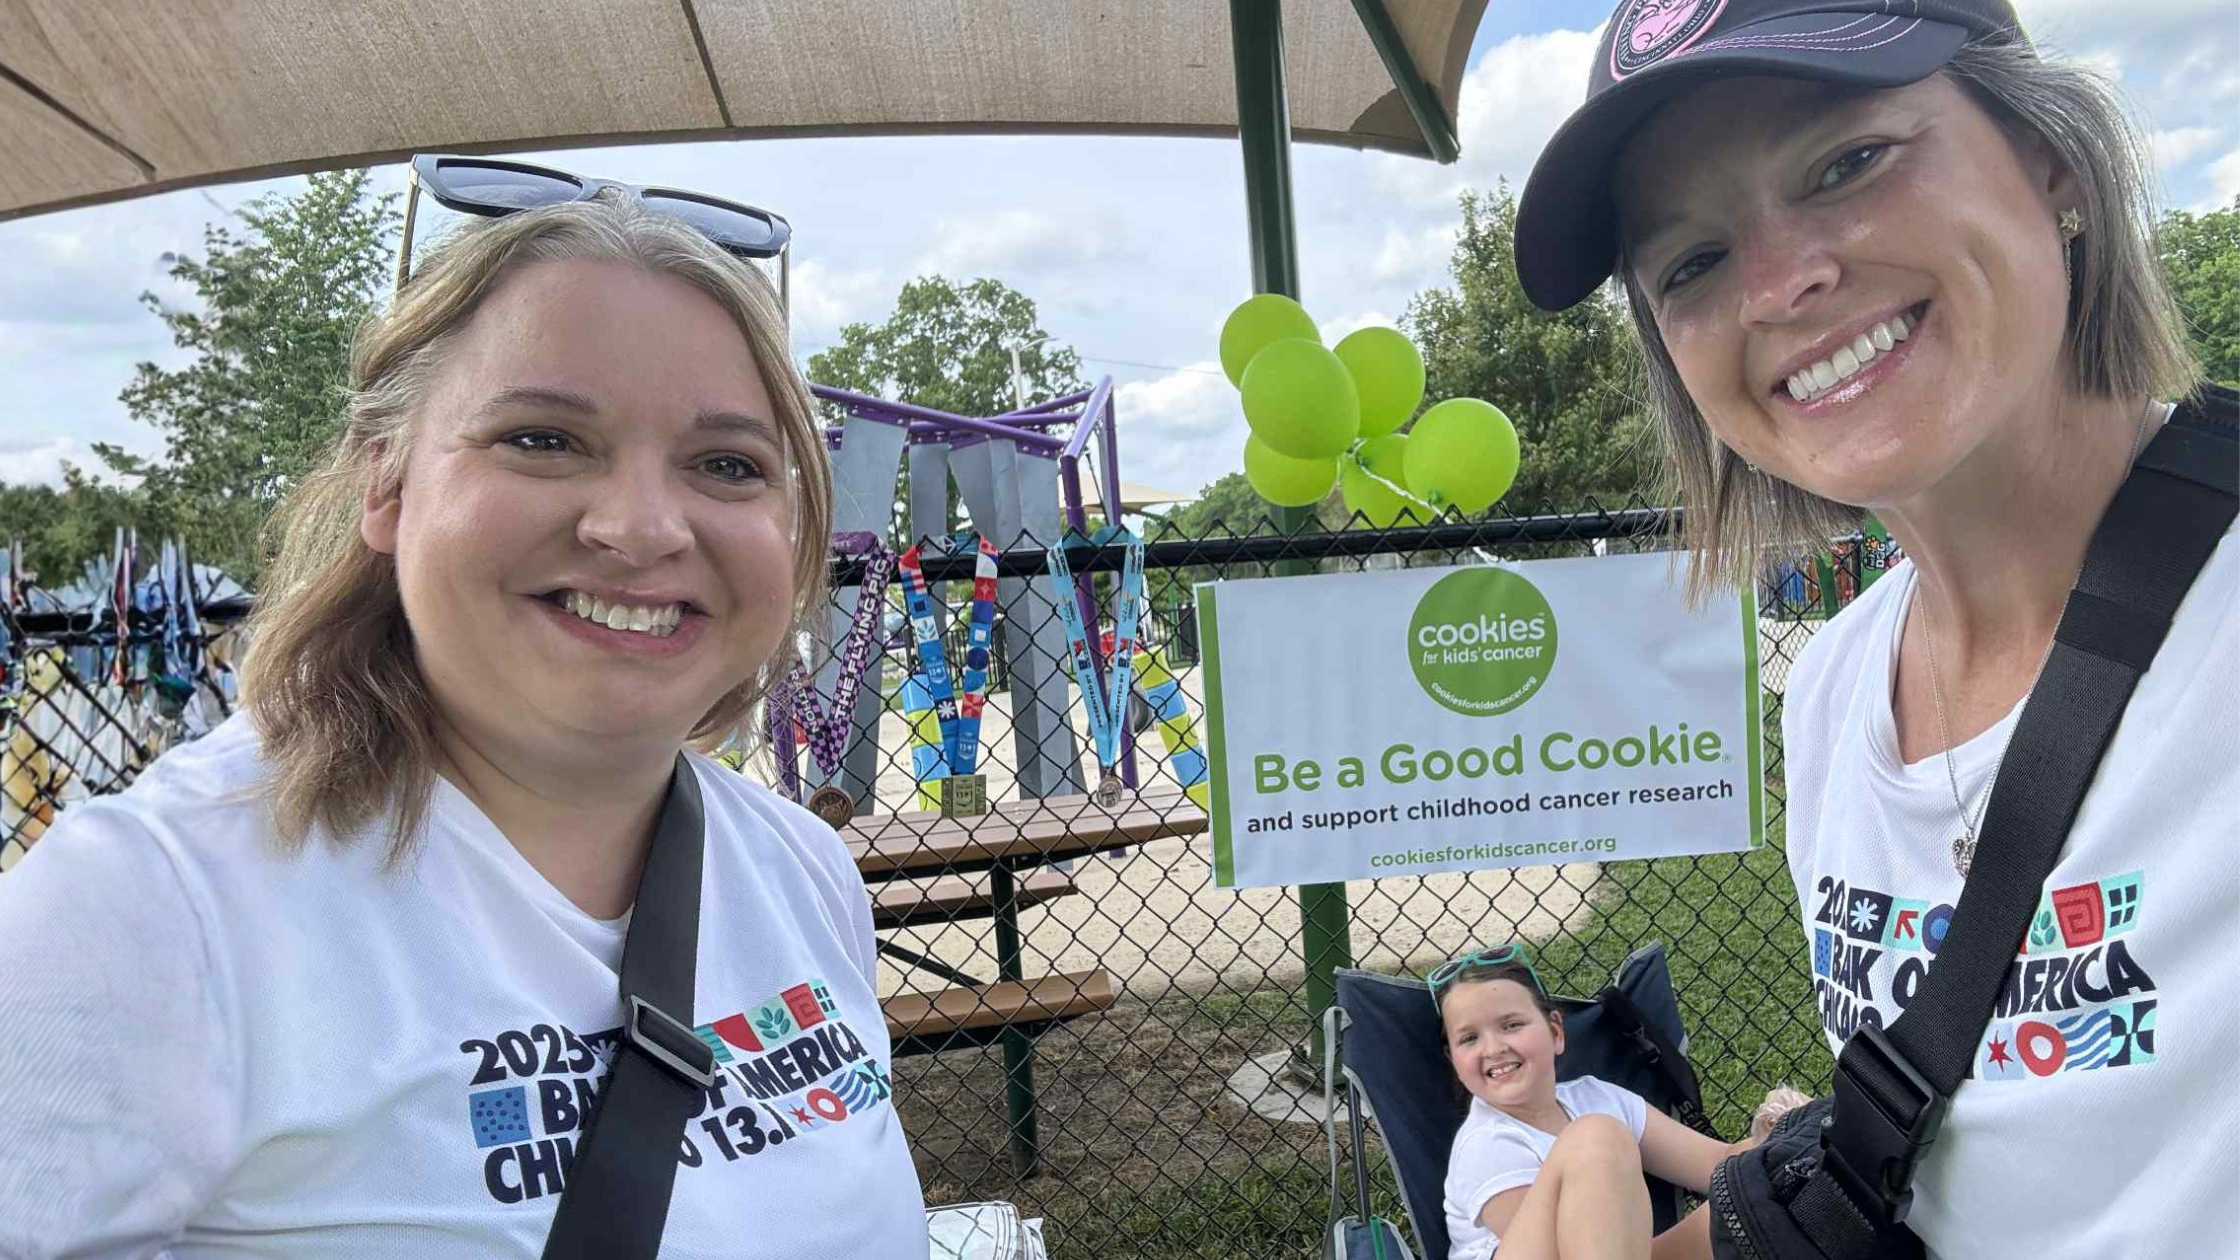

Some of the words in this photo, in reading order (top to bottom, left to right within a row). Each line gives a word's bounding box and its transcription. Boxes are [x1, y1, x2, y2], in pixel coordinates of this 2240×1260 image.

[836, 676, 855, 719] THE
[848, 597, 876, 675] FLYING
[868, 558, 888, 595] PIG
[1422, 651, 1439, 666] for
[1482, 645, 1544, 662] cancer
[789, 669, 820, 733] RATHON
[1431, 676, 1537, 710] cookiesforkidscancer.org
[1254, 754, 1323, 794] Be
[1337, 757, 1365, 788] a
[1380, 733, 1524, 785] Good
[1247, 811, 1293, 833] and
[1302, 804, 1398, 830] support
[1407, 793, 1530, 820] childhood
[1539, 790, 1620, 810] cancer
[1629, 779, 1733, 804] research
[1371, 836, 1617, 868] cookiesforkidscancer.org
[1832, 933, 1883, 1001] BAK
[1995, 939, 2157, 1019] MERICA
[459, 1023, 596, 1086] 2025
[700, 1101, 797, 1162] 13.1
